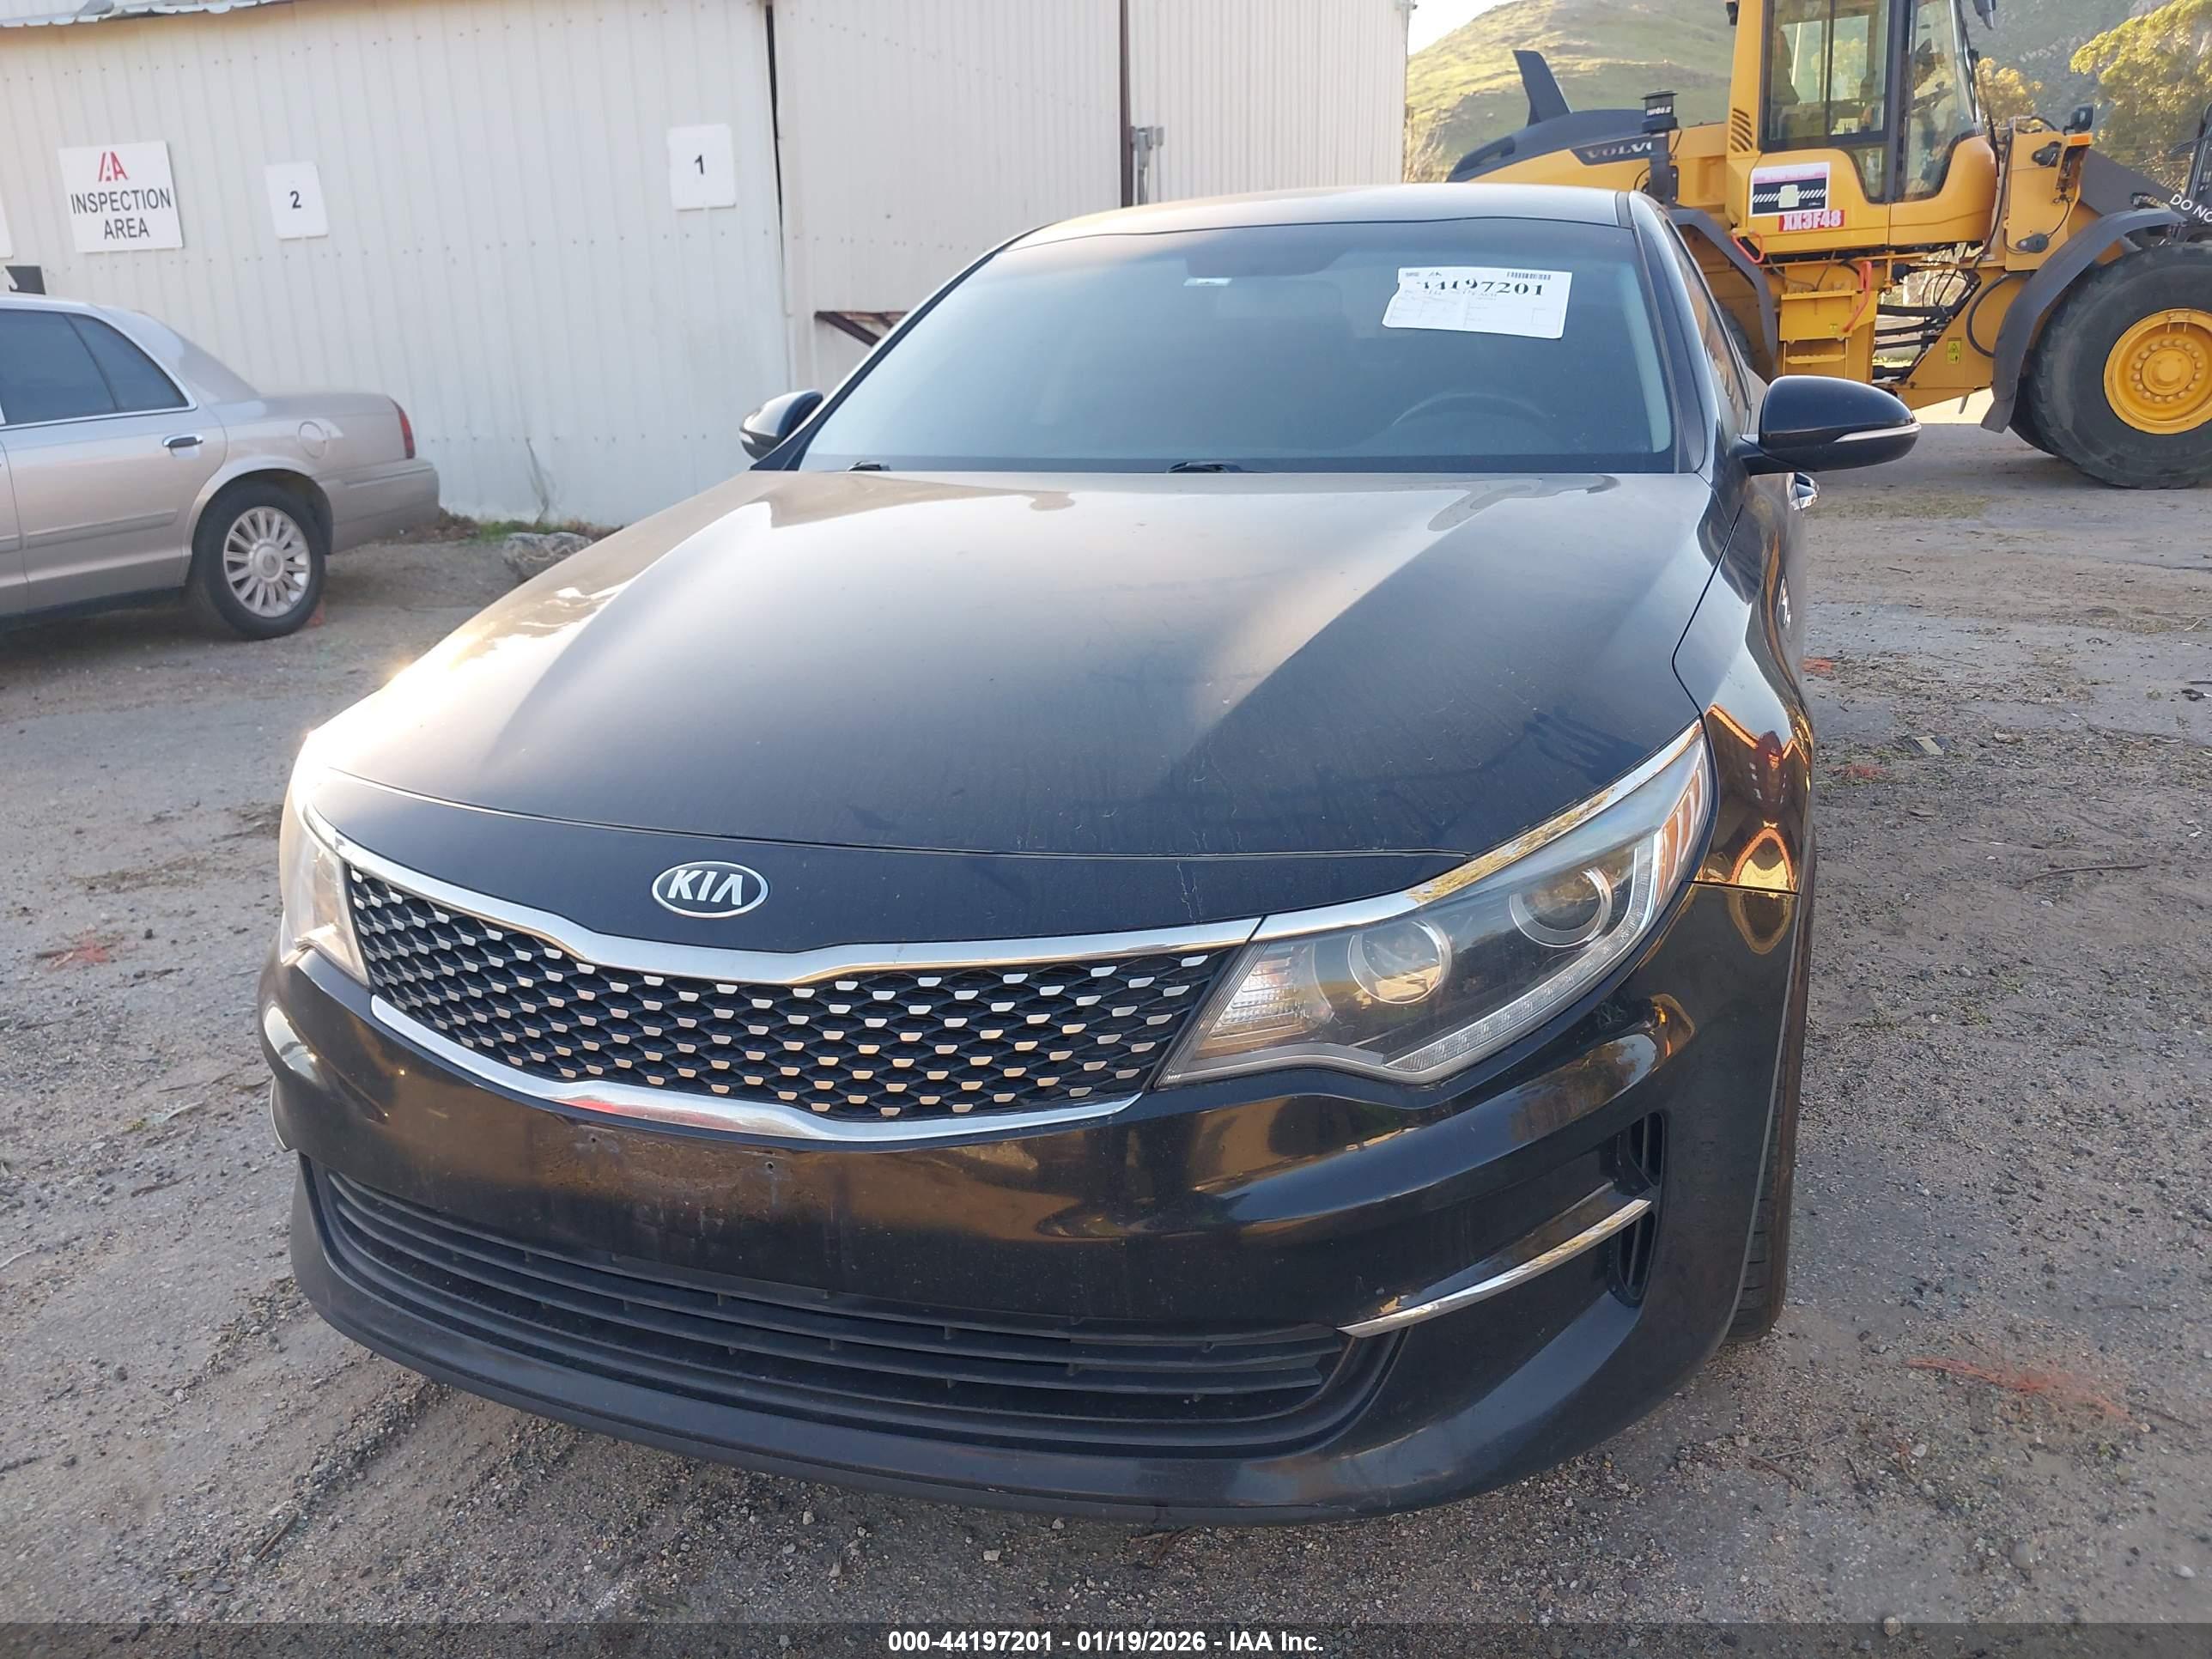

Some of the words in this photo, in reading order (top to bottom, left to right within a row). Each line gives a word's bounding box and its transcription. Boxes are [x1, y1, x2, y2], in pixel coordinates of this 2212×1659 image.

[694, 155, 704, 175] 1
[70, 187, 172, 215] INSPECTION
[289, 191, 302, 209] 2
[2170, 193, 2193, 210] DO
[104, 216, 150, 240] AREA
[666, 869, 744, 906] KIA
